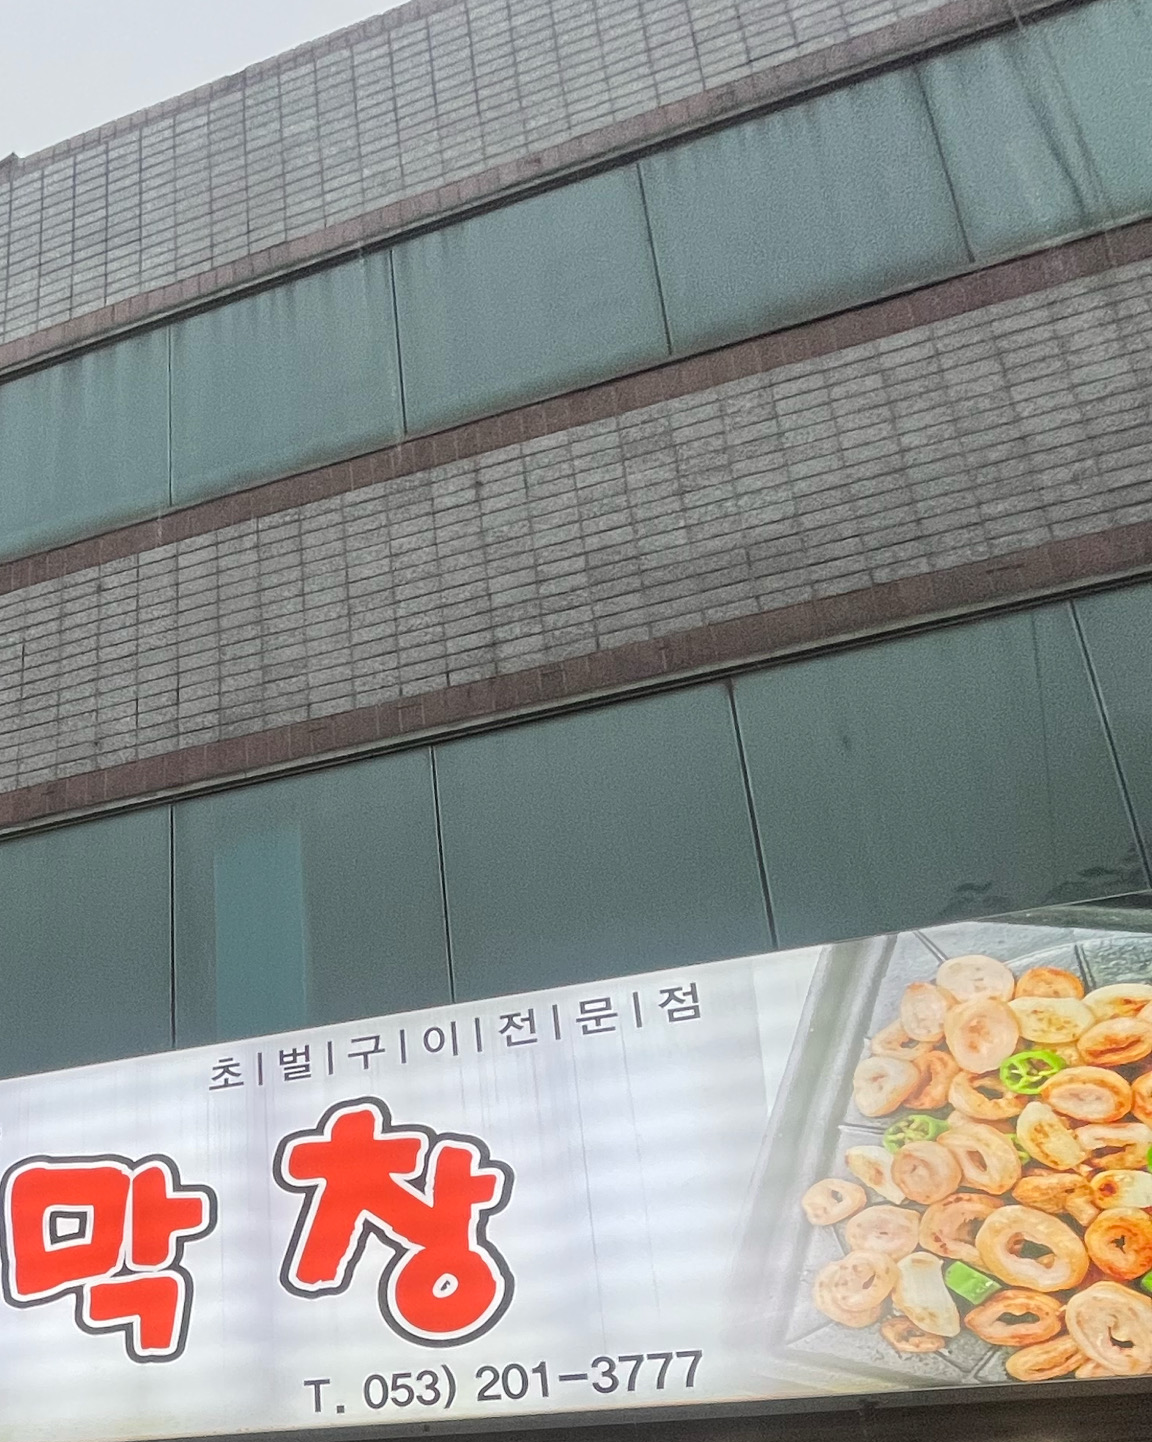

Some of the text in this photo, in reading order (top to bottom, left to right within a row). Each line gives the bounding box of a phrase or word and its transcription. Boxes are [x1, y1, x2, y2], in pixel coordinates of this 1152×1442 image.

[303, 1350, 703, 1414] T. 053) 201-3777
